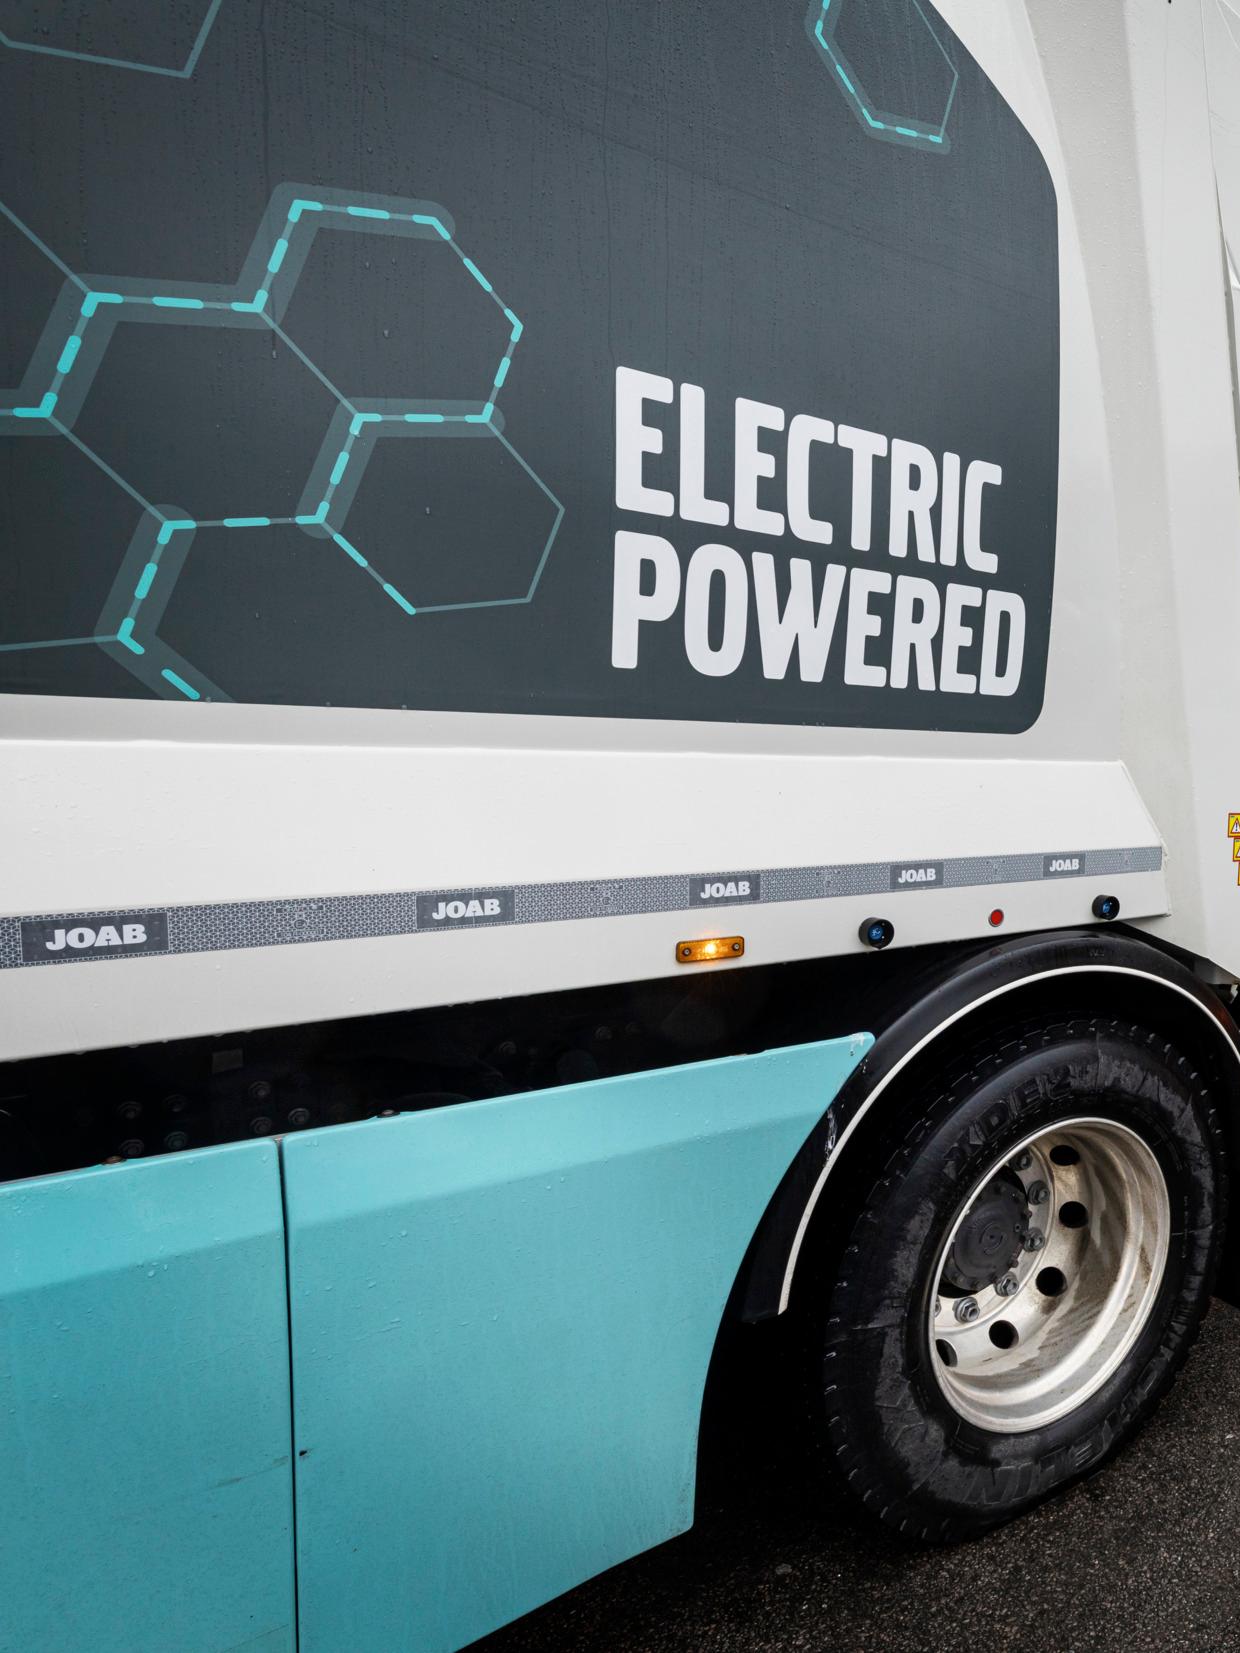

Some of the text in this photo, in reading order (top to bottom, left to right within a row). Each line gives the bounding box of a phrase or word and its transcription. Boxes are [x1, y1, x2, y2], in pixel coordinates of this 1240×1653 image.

[615, 366, 1003, 574] ELECTRIC
[611, 530, 1026, 697] POWERED
[898, 868, 936, 883] JOAB
[1049, 858, 1080, 872] JOAB
[700, 881, 750, 899] JOAB
[431, 899, 501, 920] JOAB
[45, 924, 148, 951] JOAB
